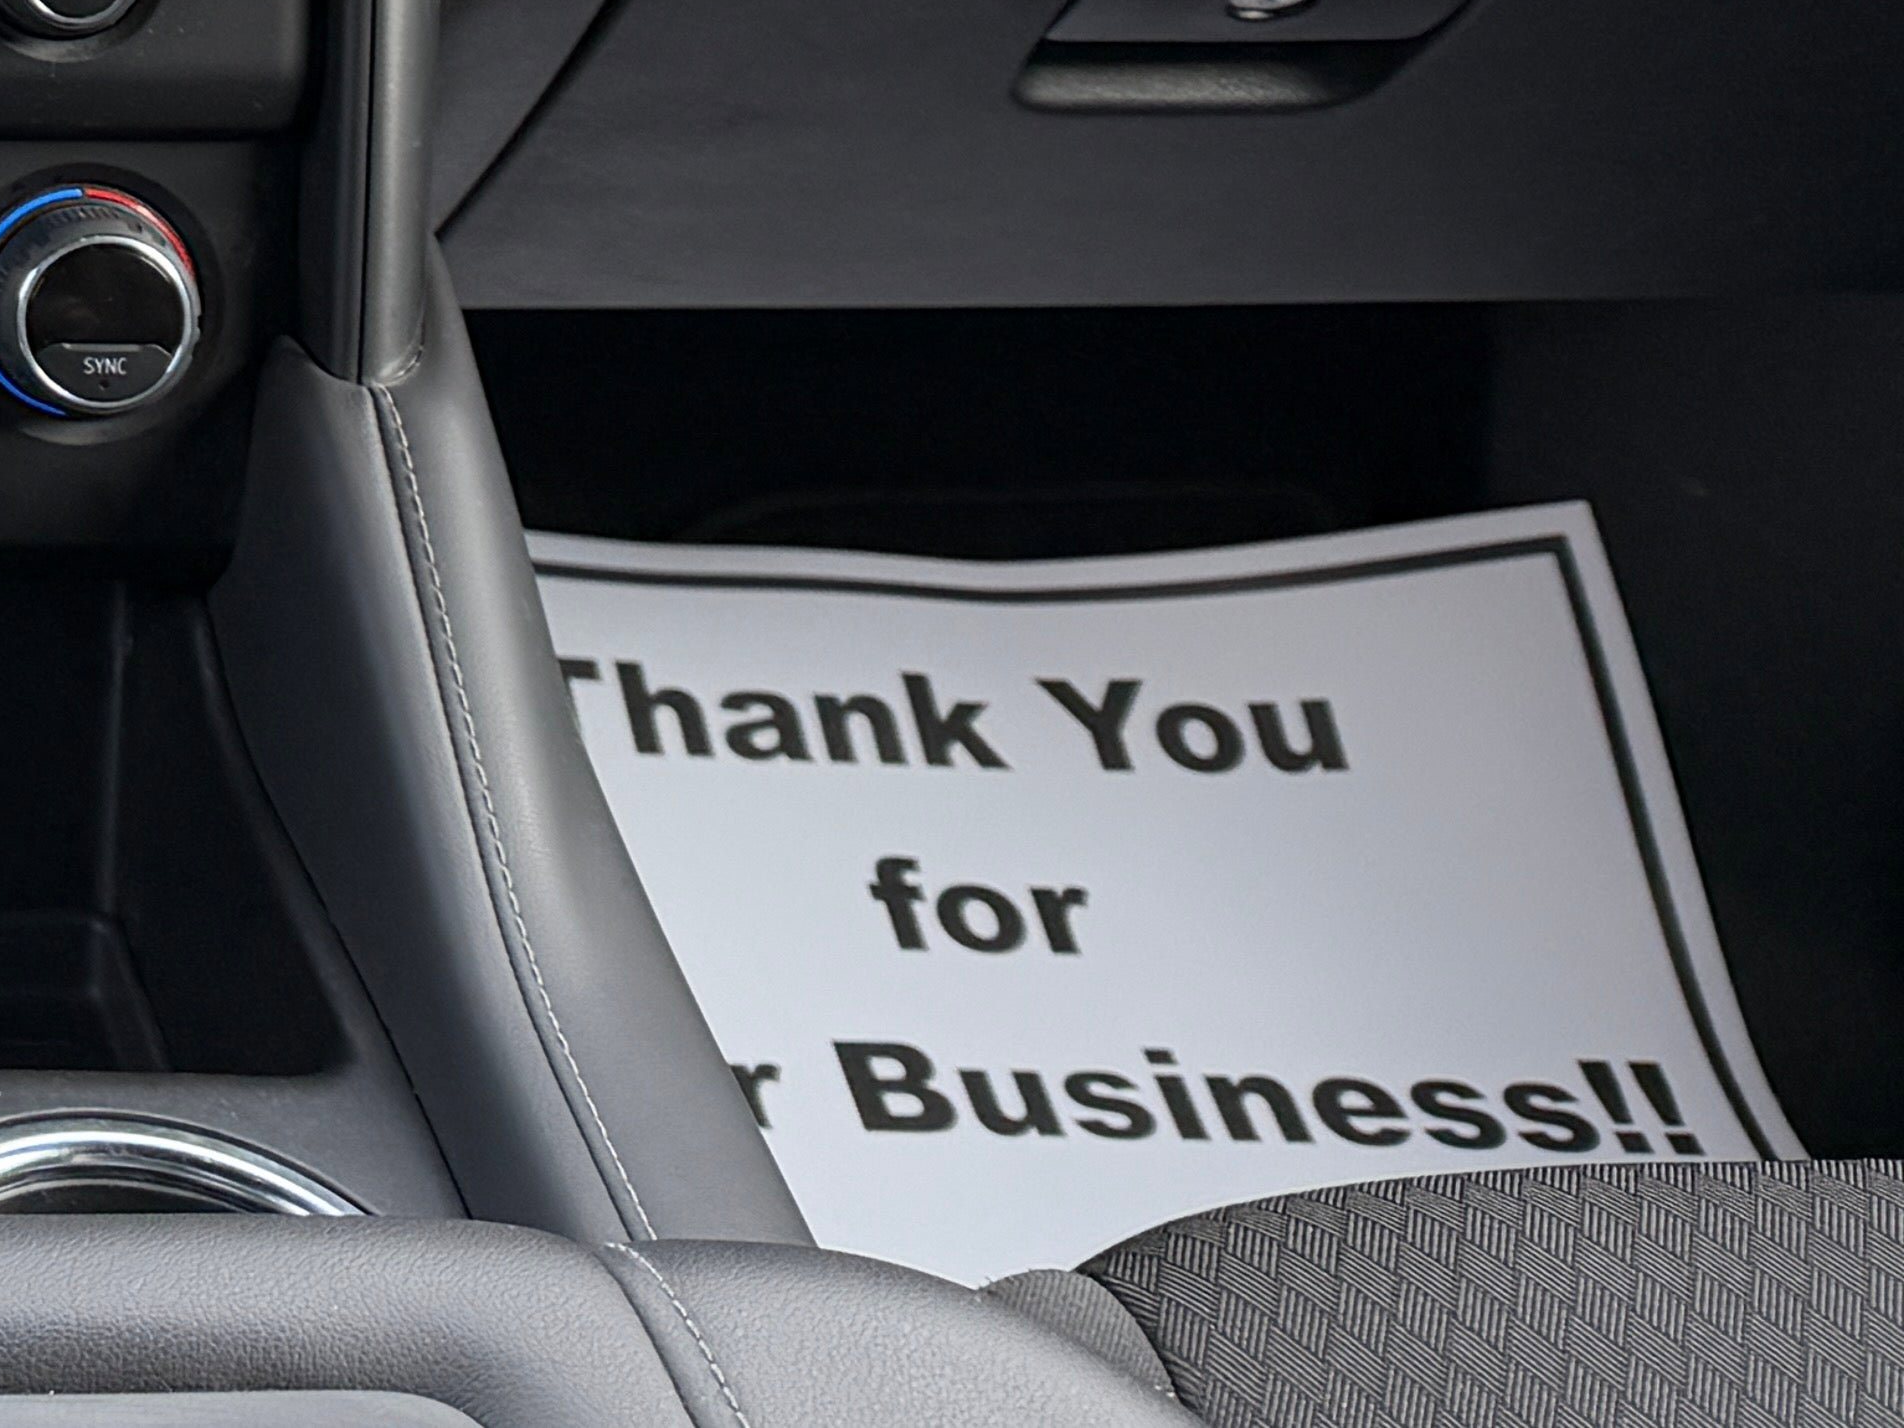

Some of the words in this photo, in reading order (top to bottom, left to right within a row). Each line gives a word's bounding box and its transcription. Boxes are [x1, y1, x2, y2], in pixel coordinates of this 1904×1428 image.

[83, 356, 127, 376] SYNC
[1035, 674, 1351, 776] You
[868, 853, 1091, 959] for
[830, 1036, 1710, 1160] Business!!
